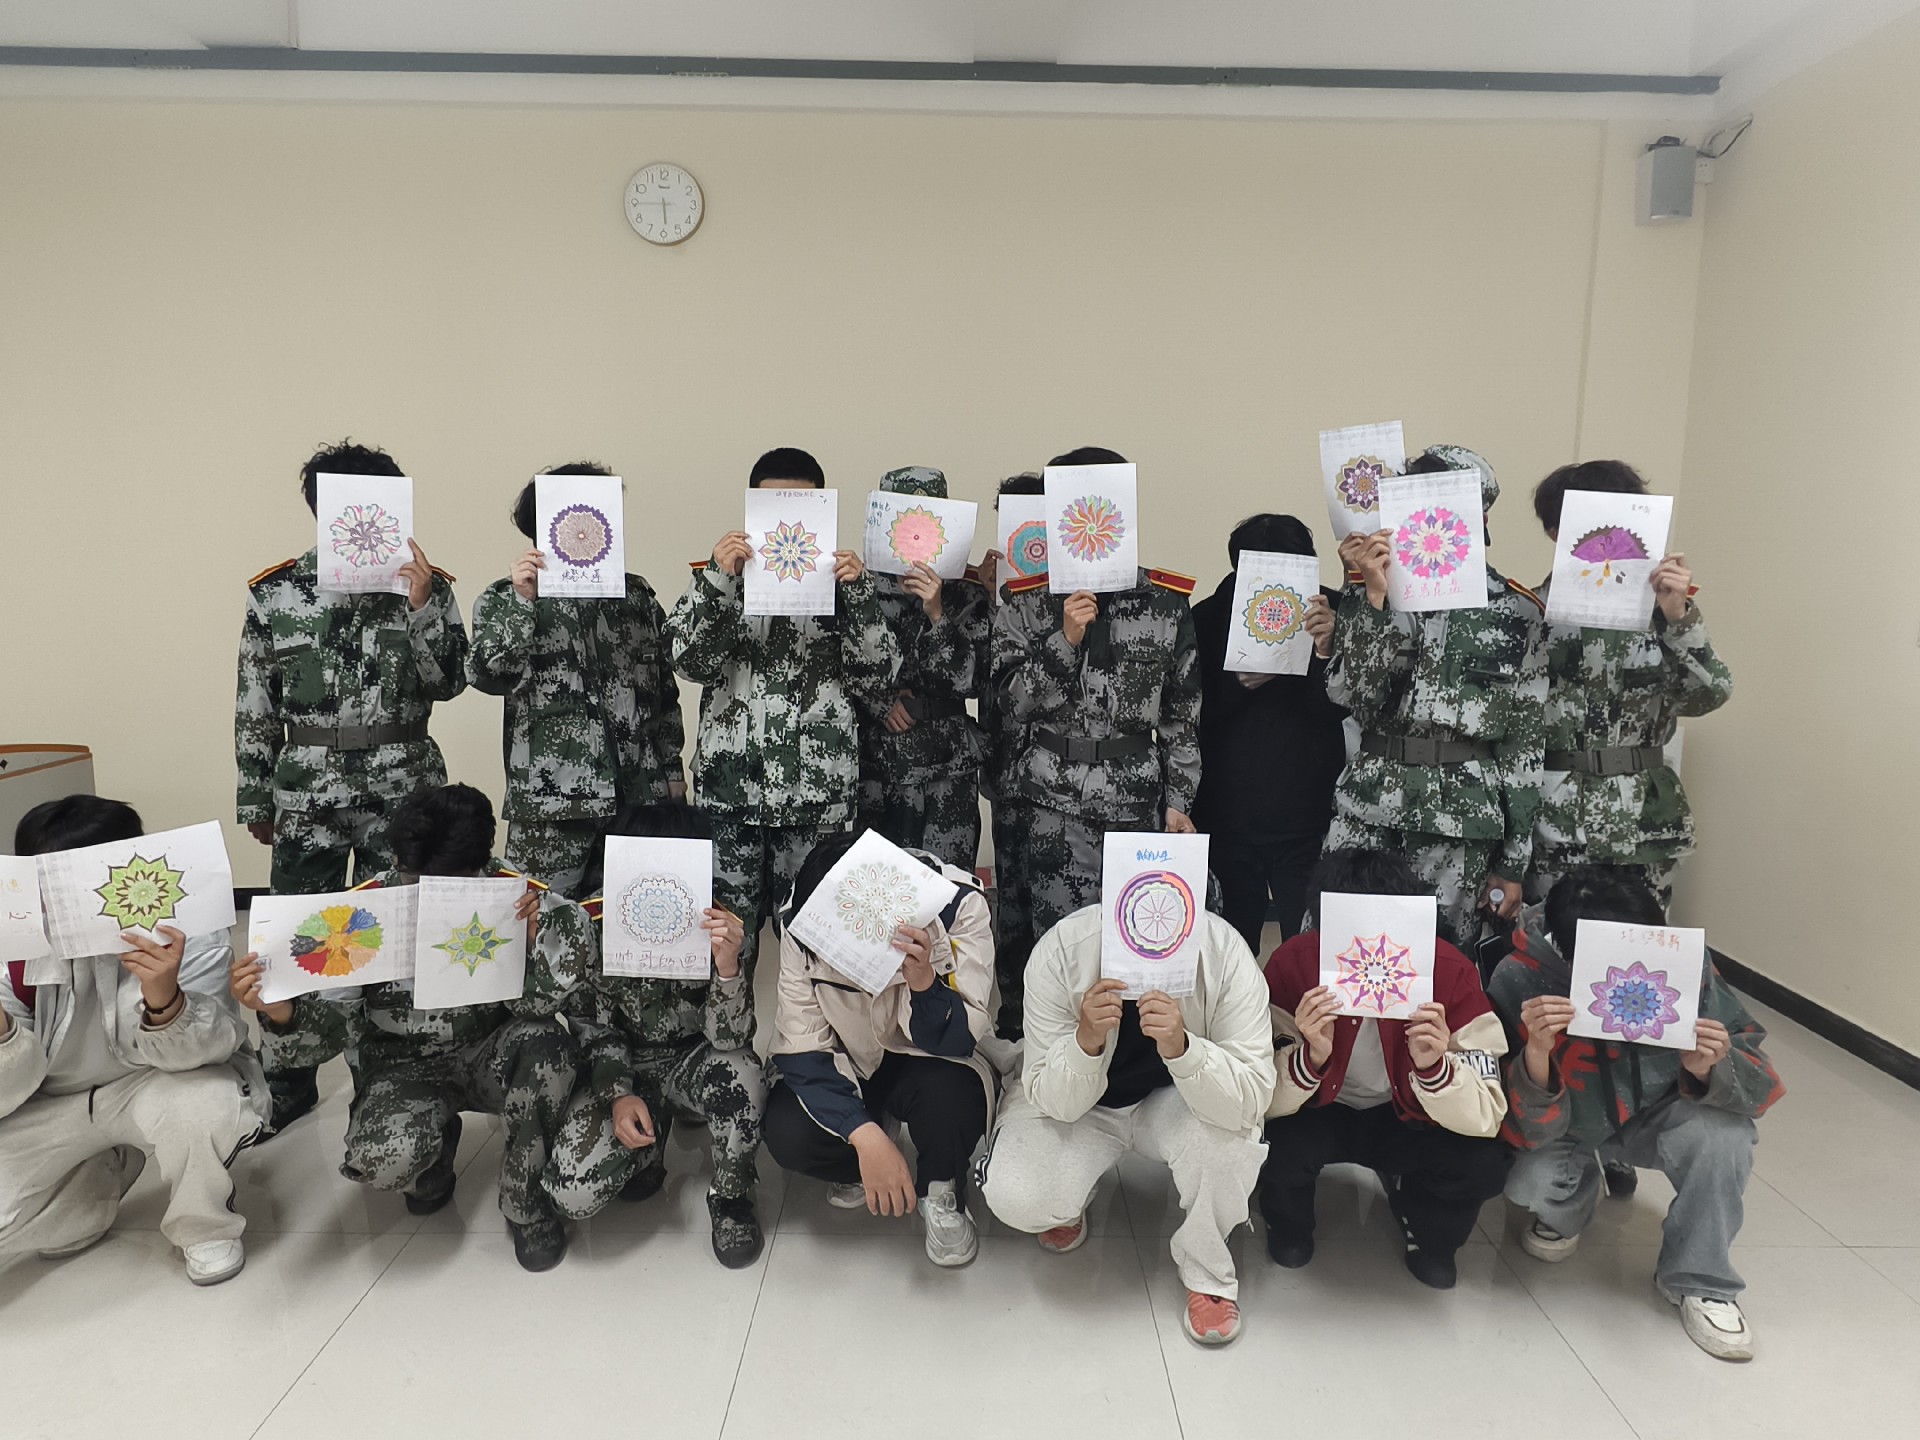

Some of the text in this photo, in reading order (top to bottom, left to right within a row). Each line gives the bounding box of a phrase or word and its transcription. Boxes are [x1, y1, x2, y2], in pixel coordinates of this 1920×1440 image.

[646, 171, 654, 184] 11
[660, 170, 670, 180] 12
[636, 184, 646, 194] 10
[686, 186, 692, 196] 2
[630, 198, 640, 207] 9
[690, 200, 697, 210] 3
[636, 213, 642, 224] 8
[684, 215, 692, 224] 4
[648, 224, 654, 234] 7
[660, 229, 668, 238] 6
[674, 224, 682, 234] 5
